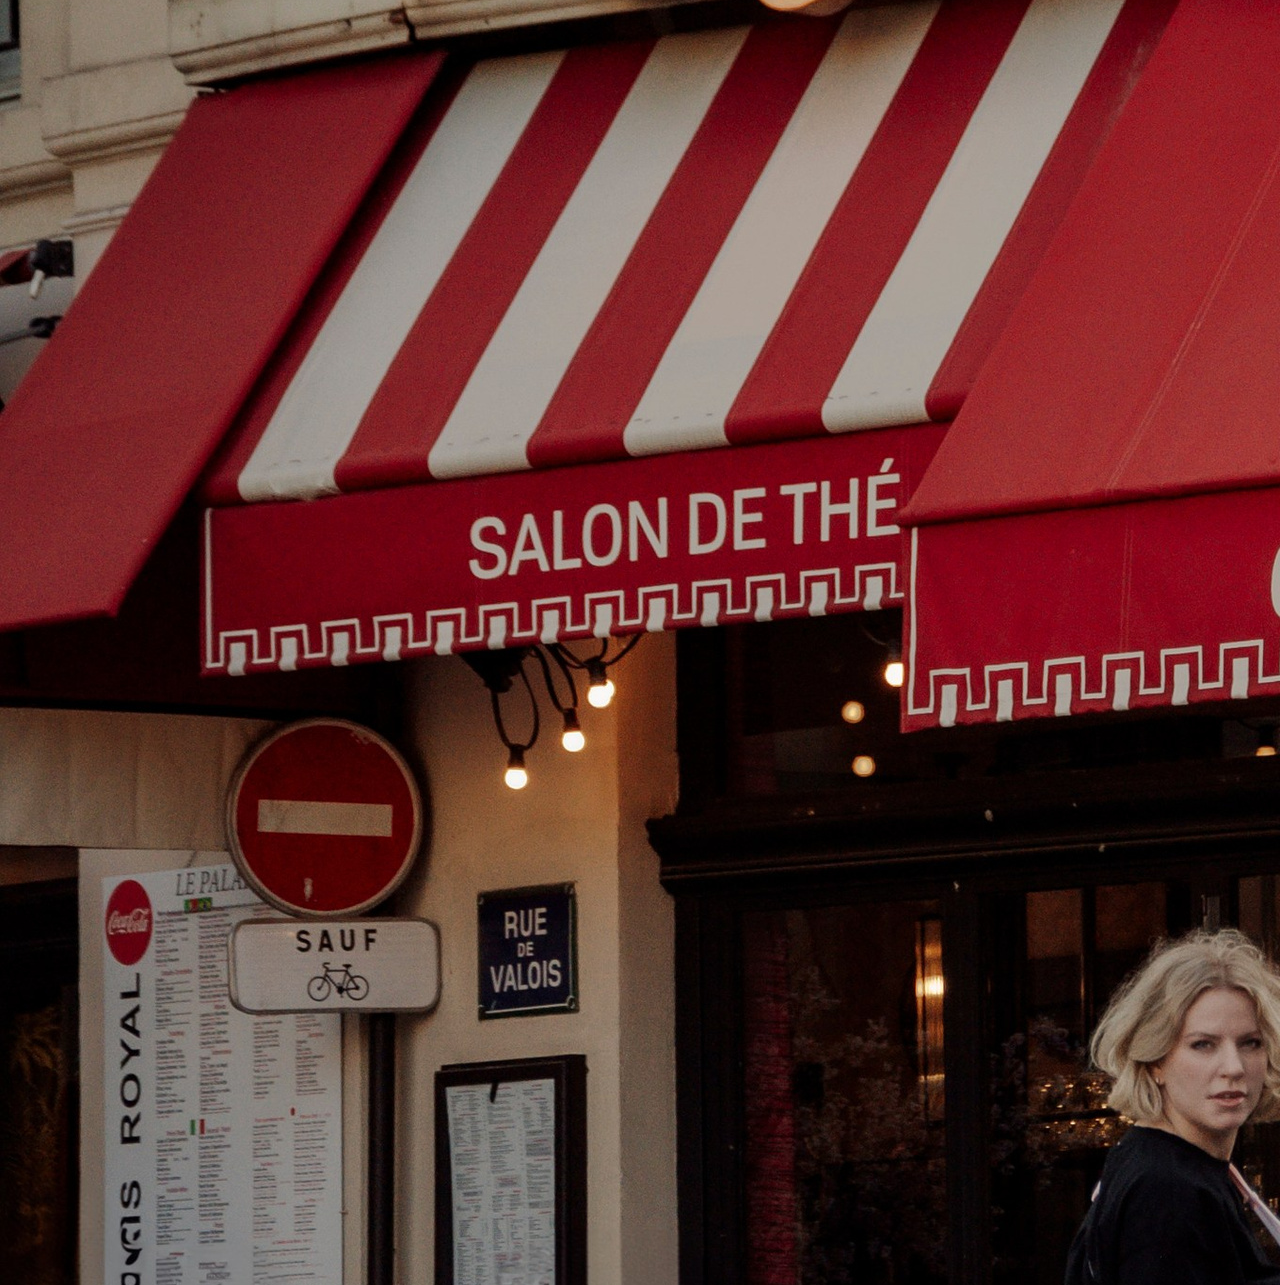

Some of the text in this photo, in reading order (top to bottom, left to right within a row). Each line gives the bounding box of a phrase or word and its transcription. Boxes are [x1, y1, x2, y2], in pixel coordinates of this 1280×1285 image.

[469, 457, 902, 580] SALON DE THÉ
[175, 869, 248, 896] LE PALA
[504, 907, 548, 939] RUE
[296, 928, 378, 953] SAUF
[517, 941, 534, 958] DE
[490, 959, 562, 993] VALOIS
[120, 972, 142, 1145] ROYAL
